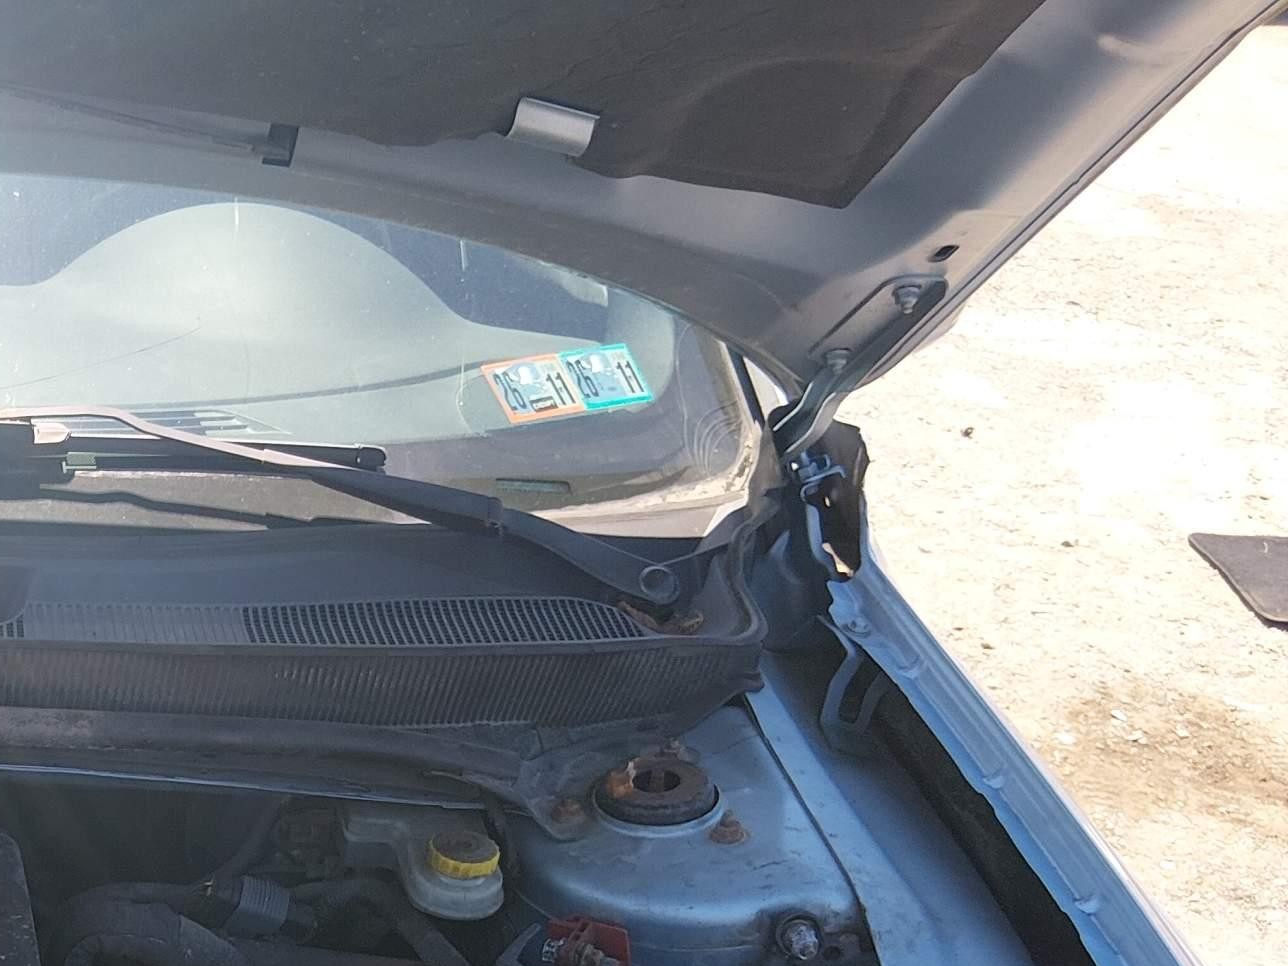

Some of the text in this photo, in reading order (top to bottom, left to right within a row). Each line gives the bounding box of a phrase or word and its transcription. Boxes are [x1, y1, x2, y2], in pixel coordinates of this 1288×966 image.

[494, 371, 577, 411] 26 11
[566, 359, 645, 399] 26 11
